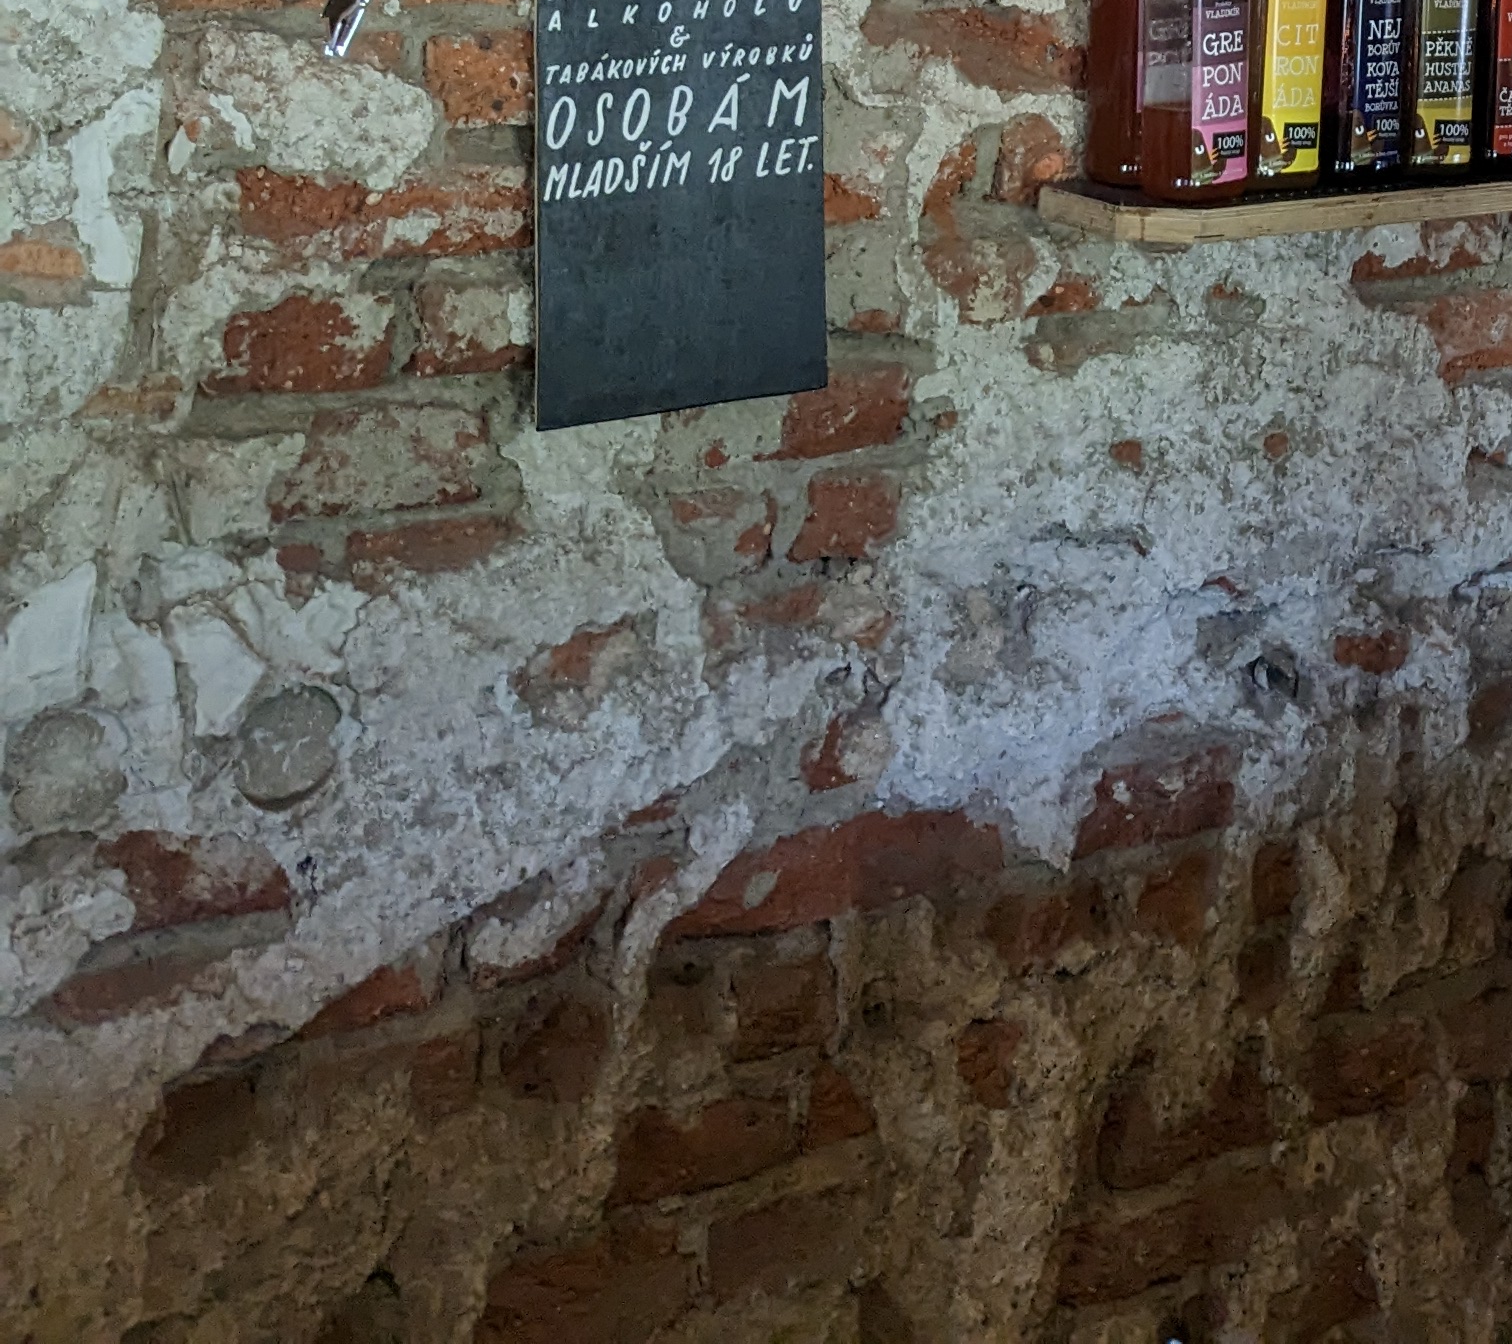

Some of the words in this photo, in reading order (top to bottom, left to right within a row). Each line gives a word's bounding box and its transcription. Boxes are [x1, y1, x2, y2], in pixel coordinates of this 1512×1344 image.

[670, 26, 690, 48] &
[1368, 19, 1402, 40] NEJ
[1203, 30, 1244, 55] GRE
[1425, 38, 1473, 58] PĚKNĚ
[545, 49, 686, 86] TABÁKOVÝCH
[702, 33, 813, 70] VÝROBKŮ
[1424, 60, 1472, 77] HUSTEJ
[1203, 62, 1243, 87] PON
[546, 73, 811, 150] OSOBÁM
[1201, 94, 1244, 120] ÁDA
[1440, 123, 1469, 138] 100%
[543, 141, 692, 201] MLADŠÍM
[708, 148, 741, 183] 18
